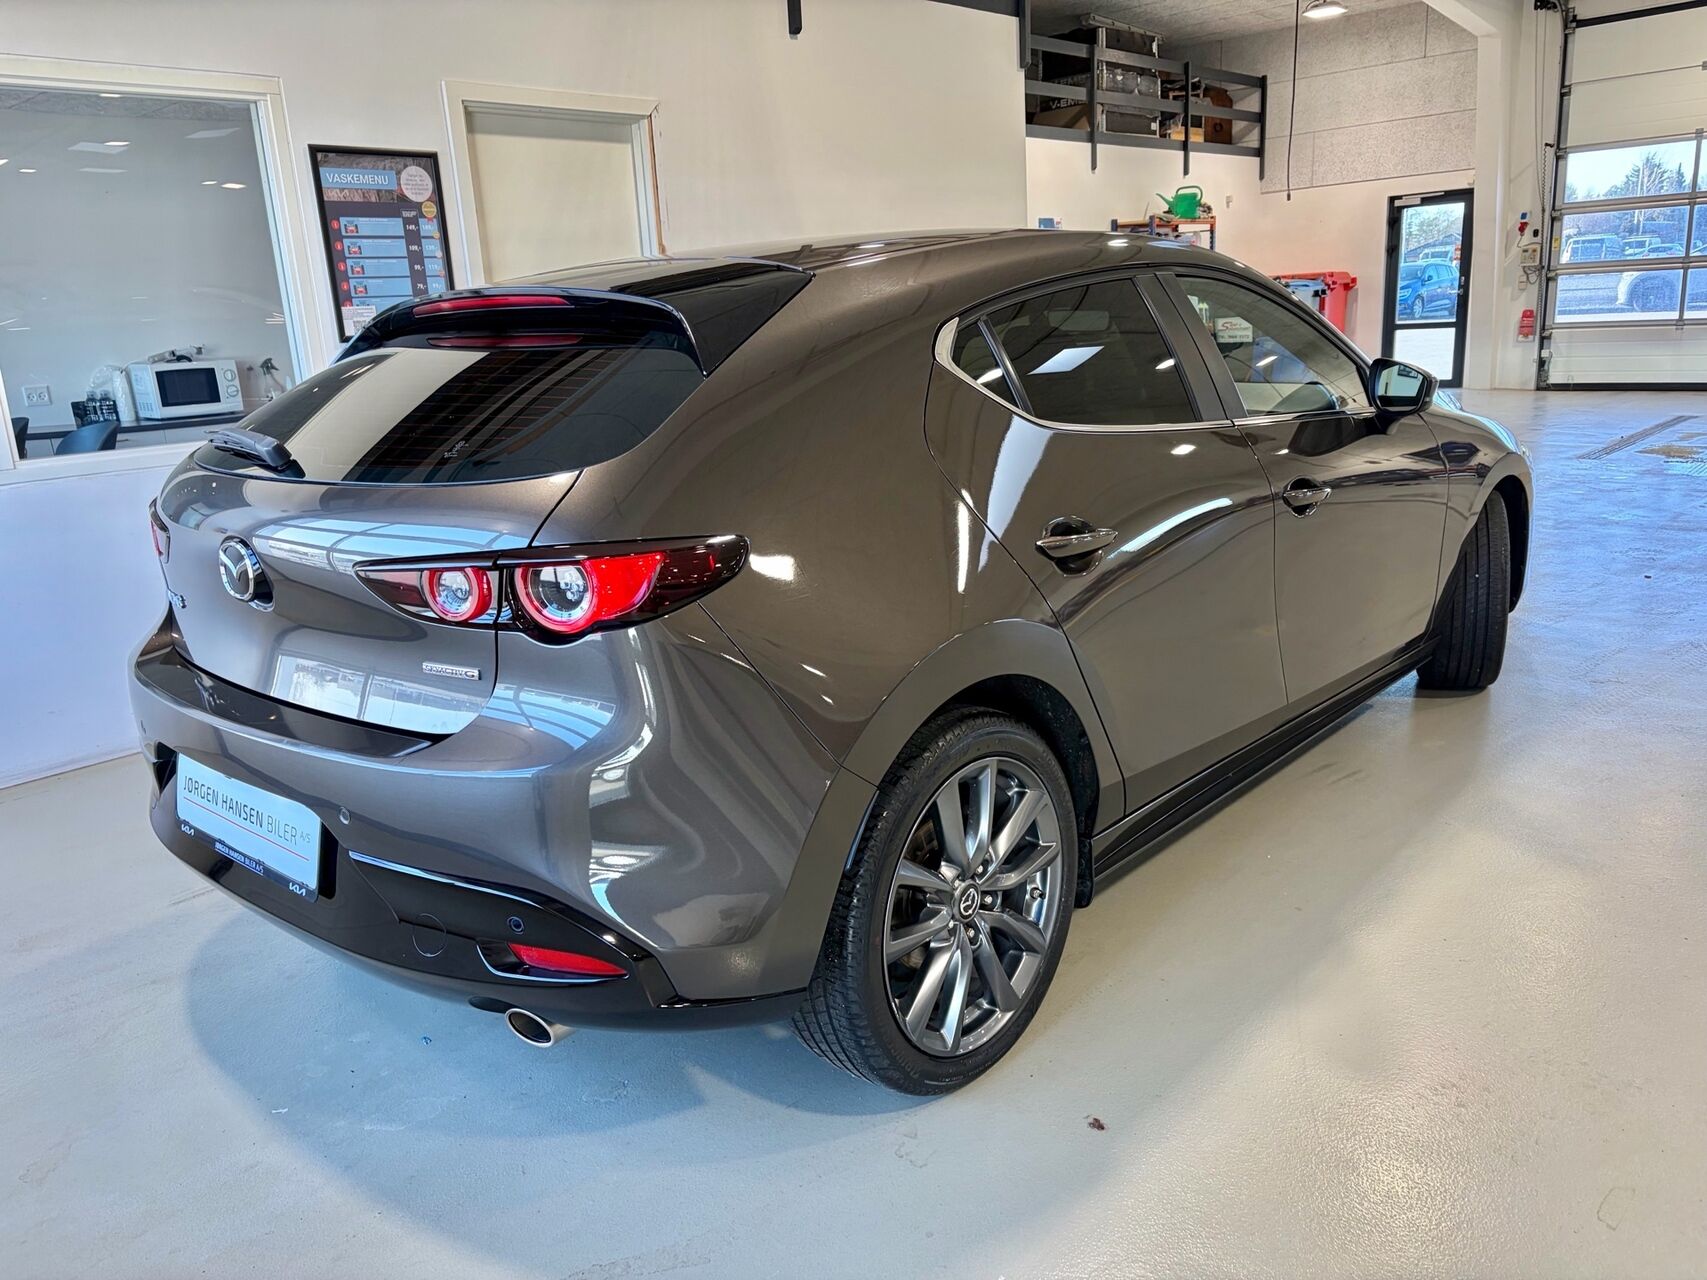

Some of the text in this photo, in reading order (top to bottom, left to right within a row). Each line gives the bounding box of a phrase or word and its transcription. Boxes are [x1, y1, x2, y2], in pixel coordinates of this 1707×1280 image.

[326, 172, 389, 186] VASKEMENU
[183, 775, 311, 846] JØRGEN HANSEN BILER A/S
